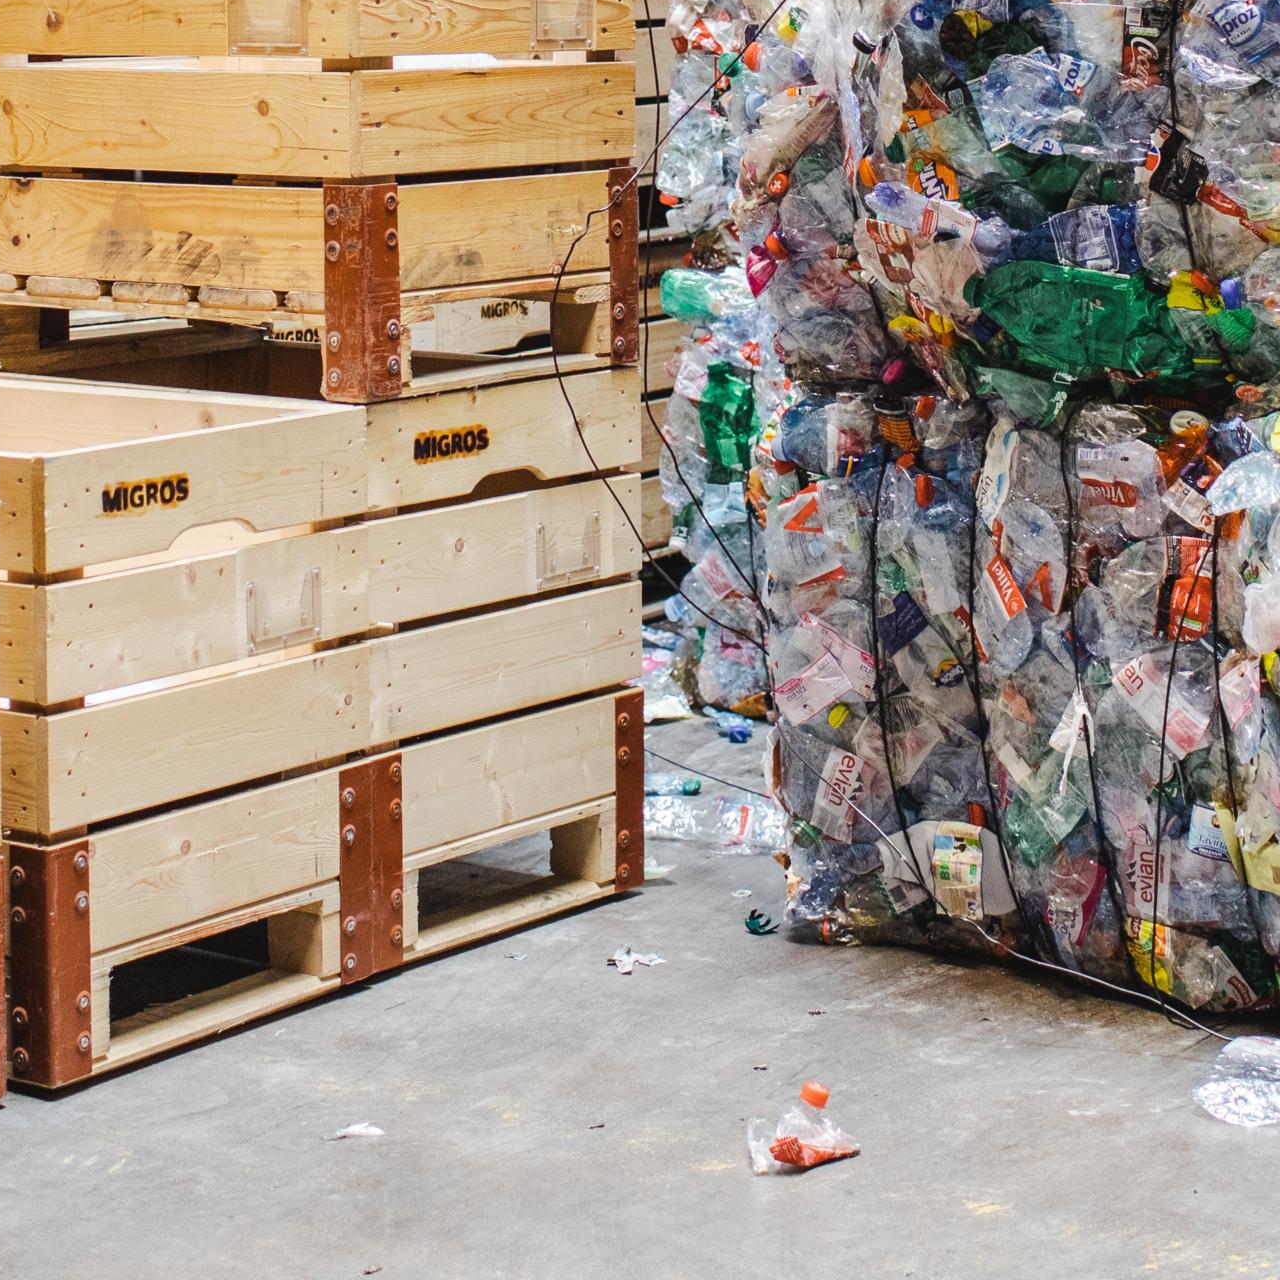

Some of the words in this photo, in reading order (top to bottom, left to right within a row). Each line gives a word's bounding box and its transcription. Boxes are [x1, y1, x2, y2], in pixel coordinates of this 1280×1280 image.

[480, 300, 529, 319] MIGROS
[413, 428, 490, 461] MIGROS
[101, 477, 189, 513] MIGROS
[991, 561, 1014, 602] Vittel
[1140, 851, 1153, 904] evian
